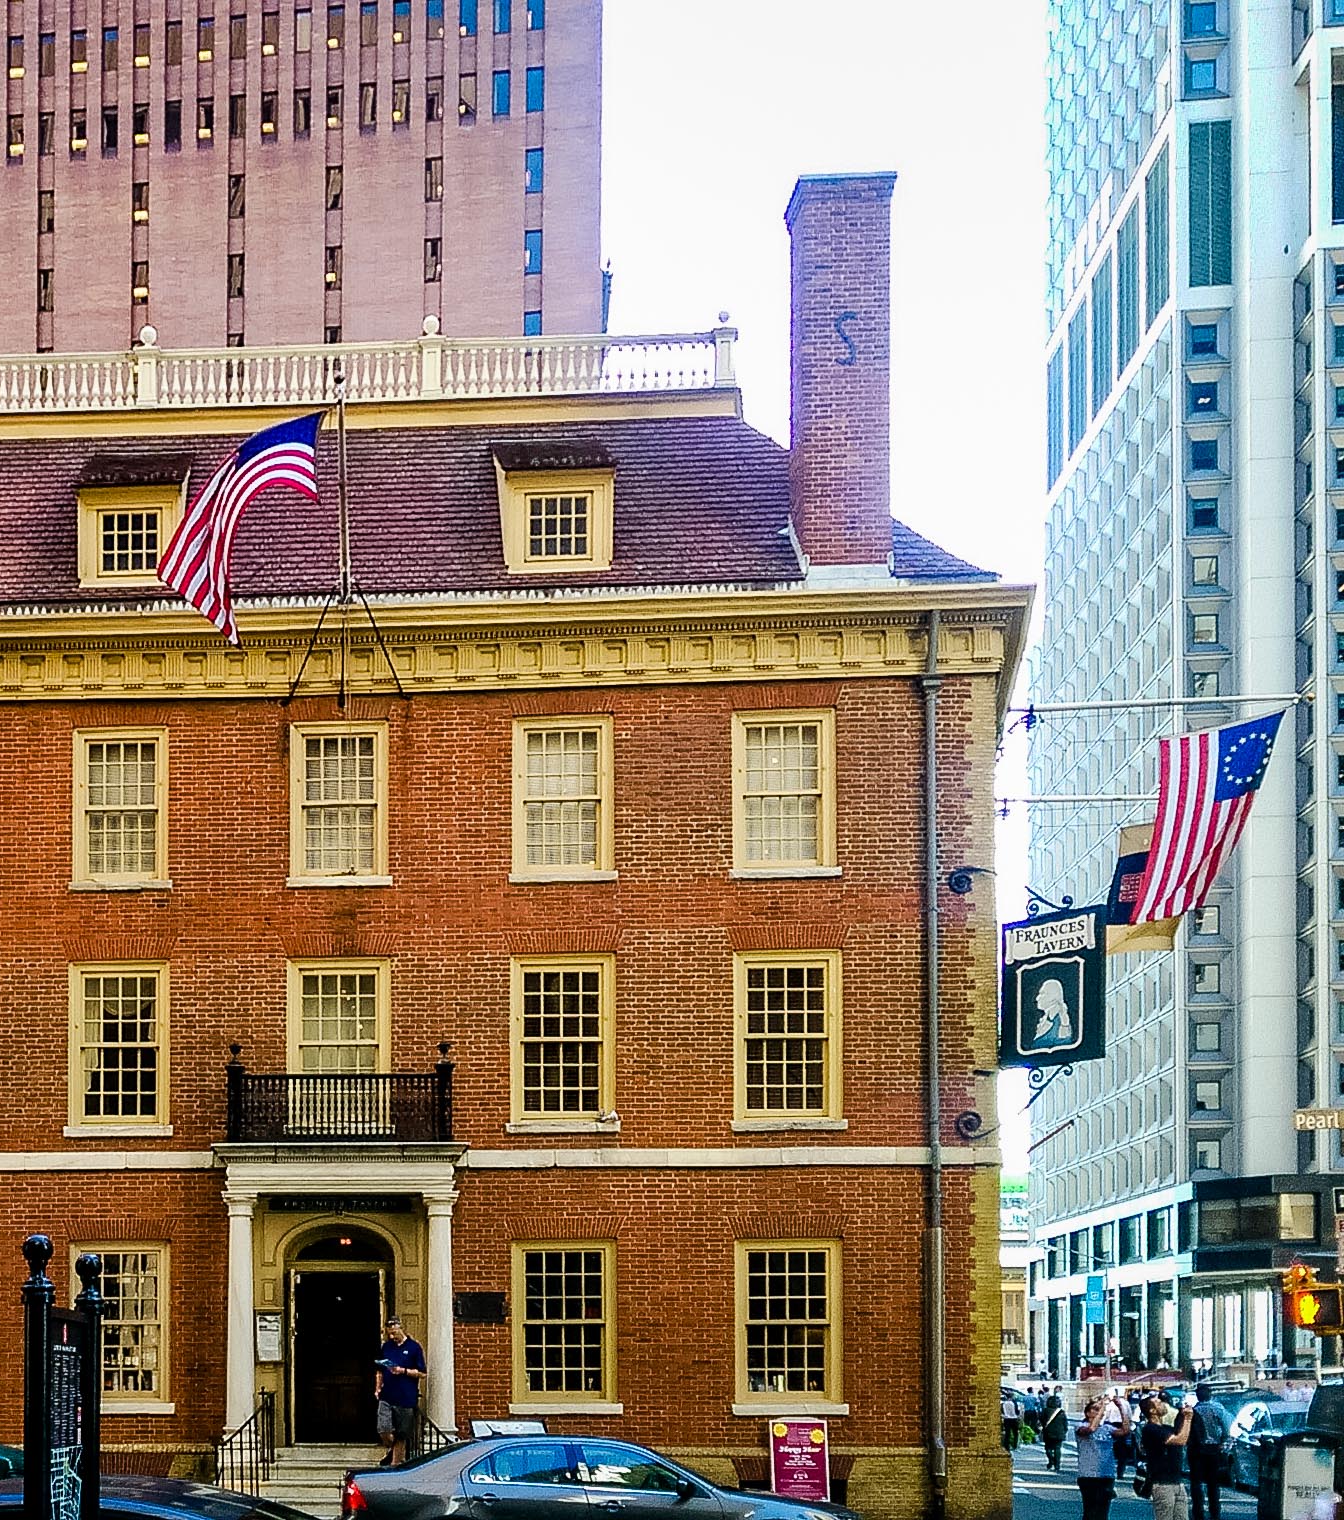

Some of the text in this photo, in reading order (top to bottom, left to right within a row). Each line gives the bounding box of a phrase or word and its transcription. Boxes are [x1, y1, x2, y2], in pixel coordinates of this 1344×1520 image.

[1015, 919, 1085, 943] FRAUNCES
[1033, 935, 1085, 954] TAVERN
[1295, 1112, 1340, 1129] Pearl
